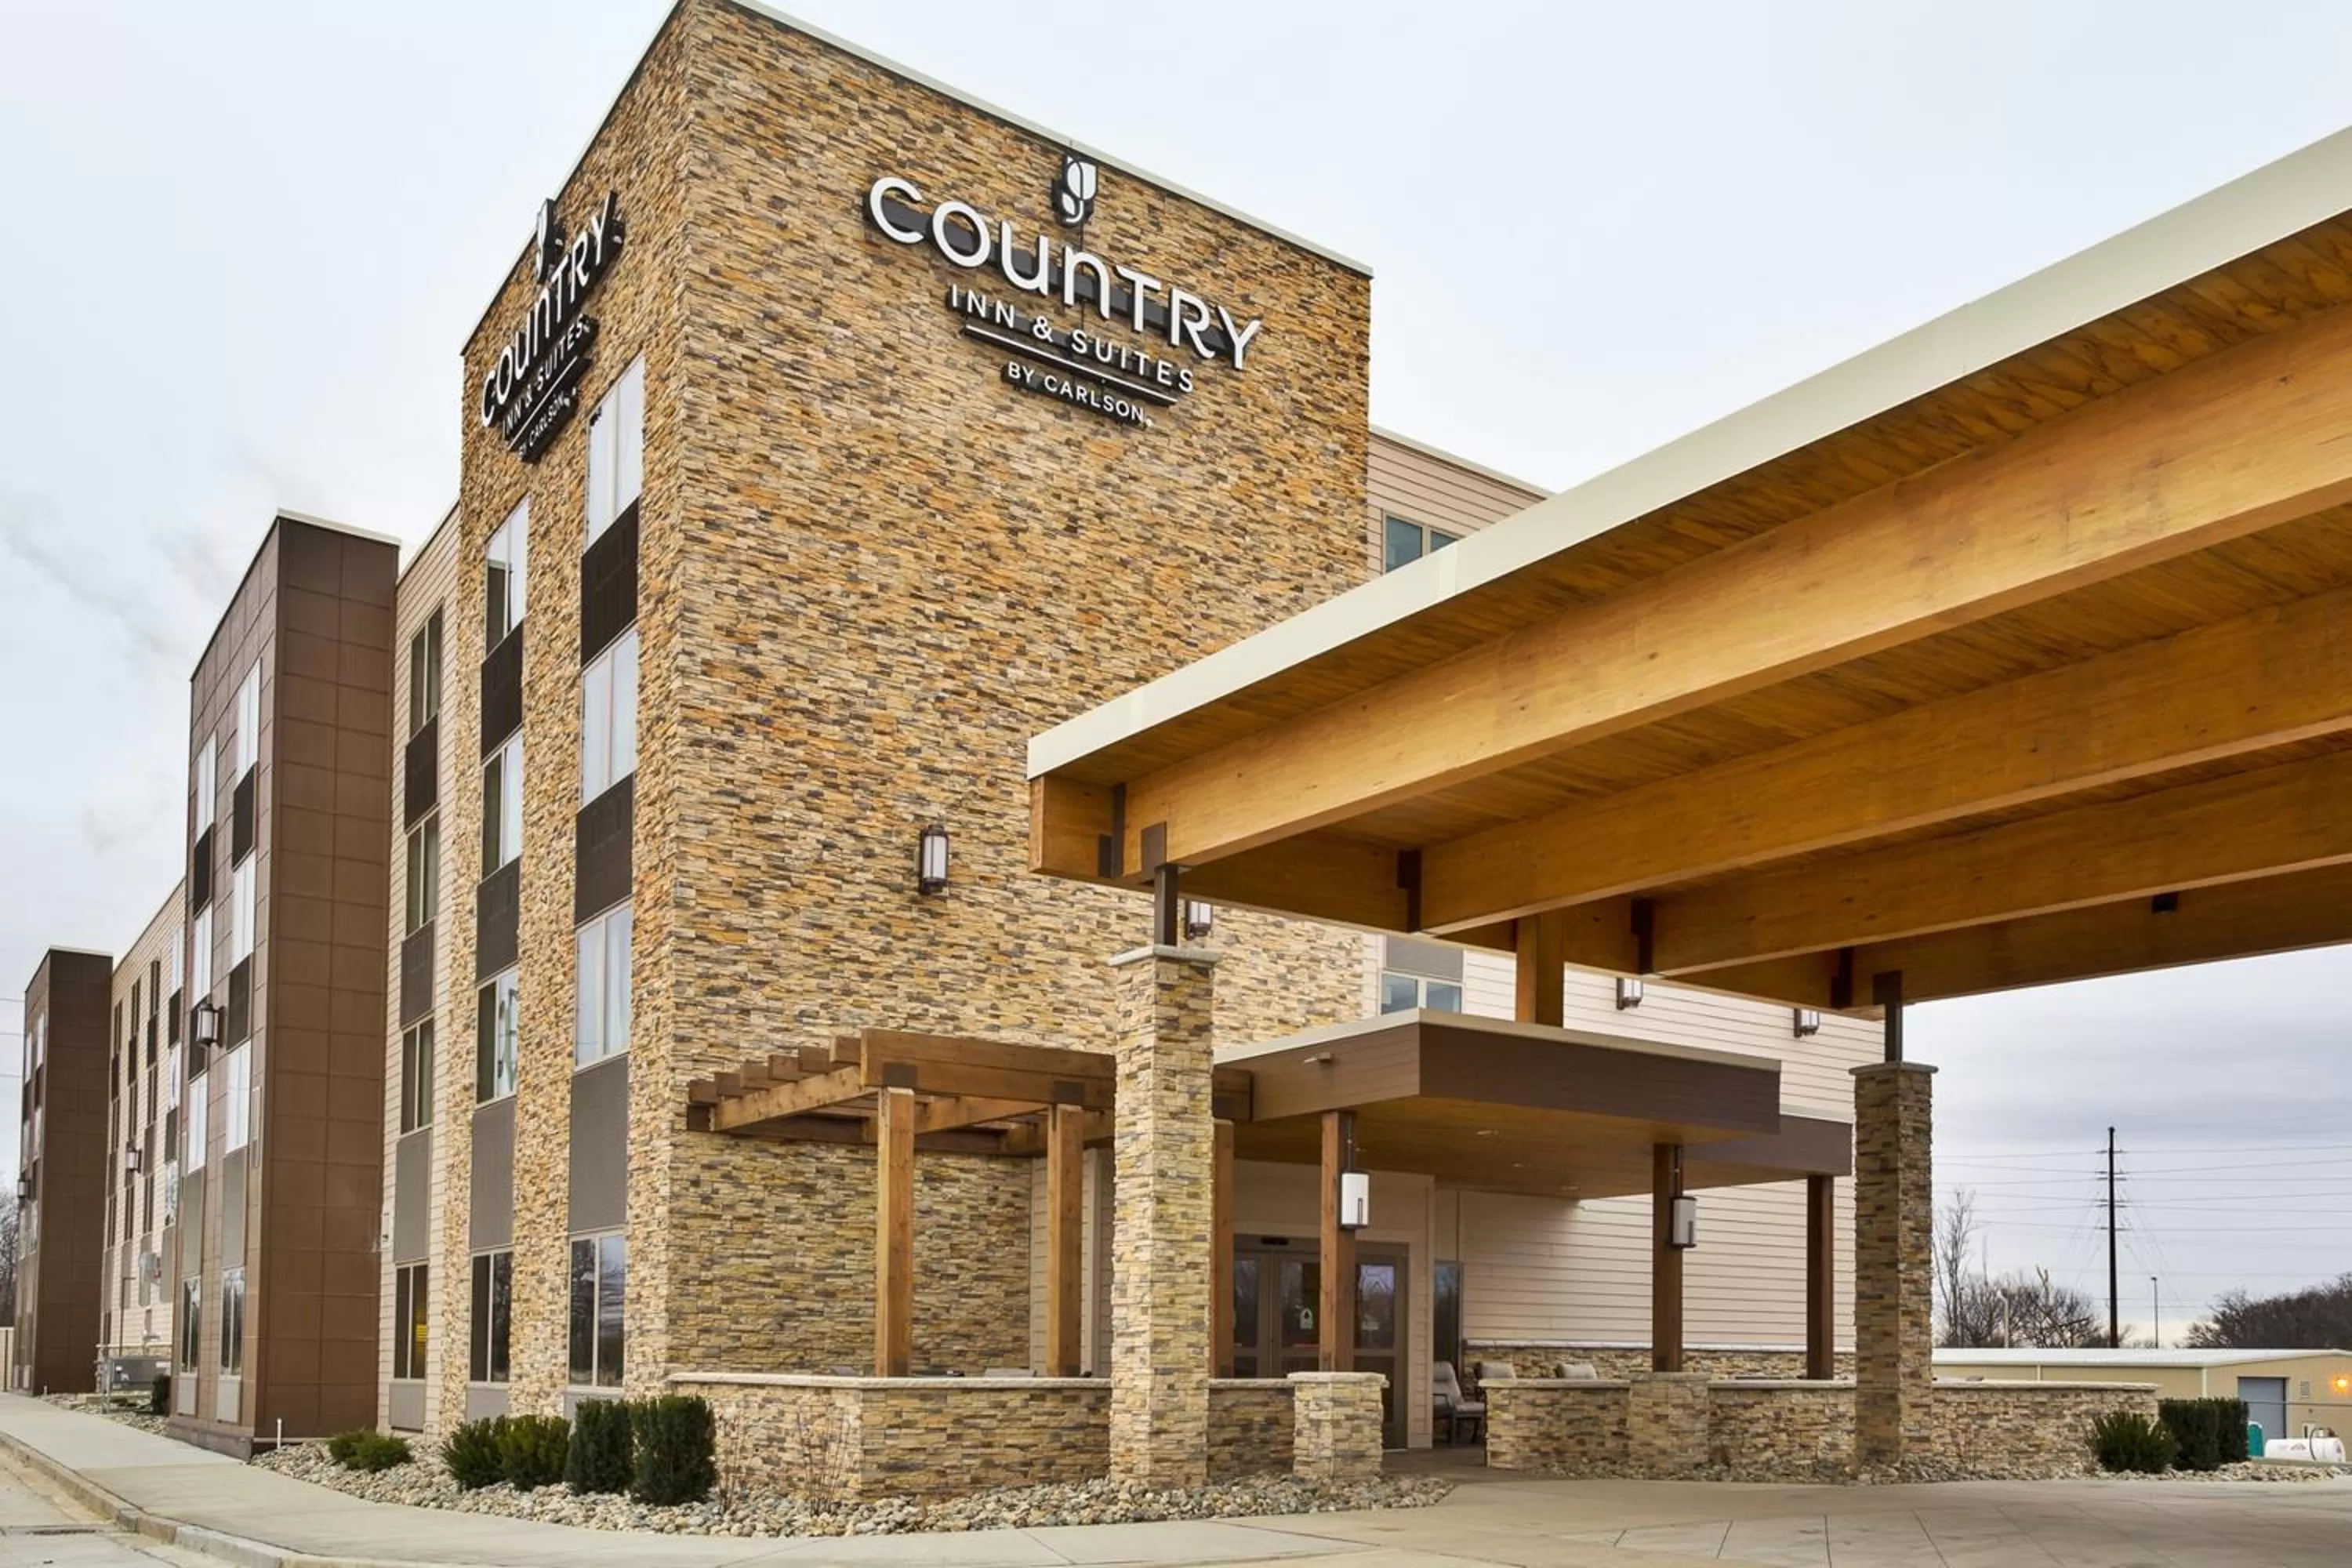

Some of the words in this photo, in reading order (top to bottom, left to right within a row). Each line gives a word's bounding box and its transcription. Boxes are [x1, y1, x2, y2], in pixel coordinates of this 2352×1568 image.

[503, 396, 521, 441] INN
[537, 313, 585, 391] SUITES
[951, 283, 1015, 328] INN
[1033, 315, 1054, 343] &
[1071, 328, 1194, 393] SUITES
[1007, 361, 1035, 384] BY
[1044, 374, 1145, 424] CARLSON
